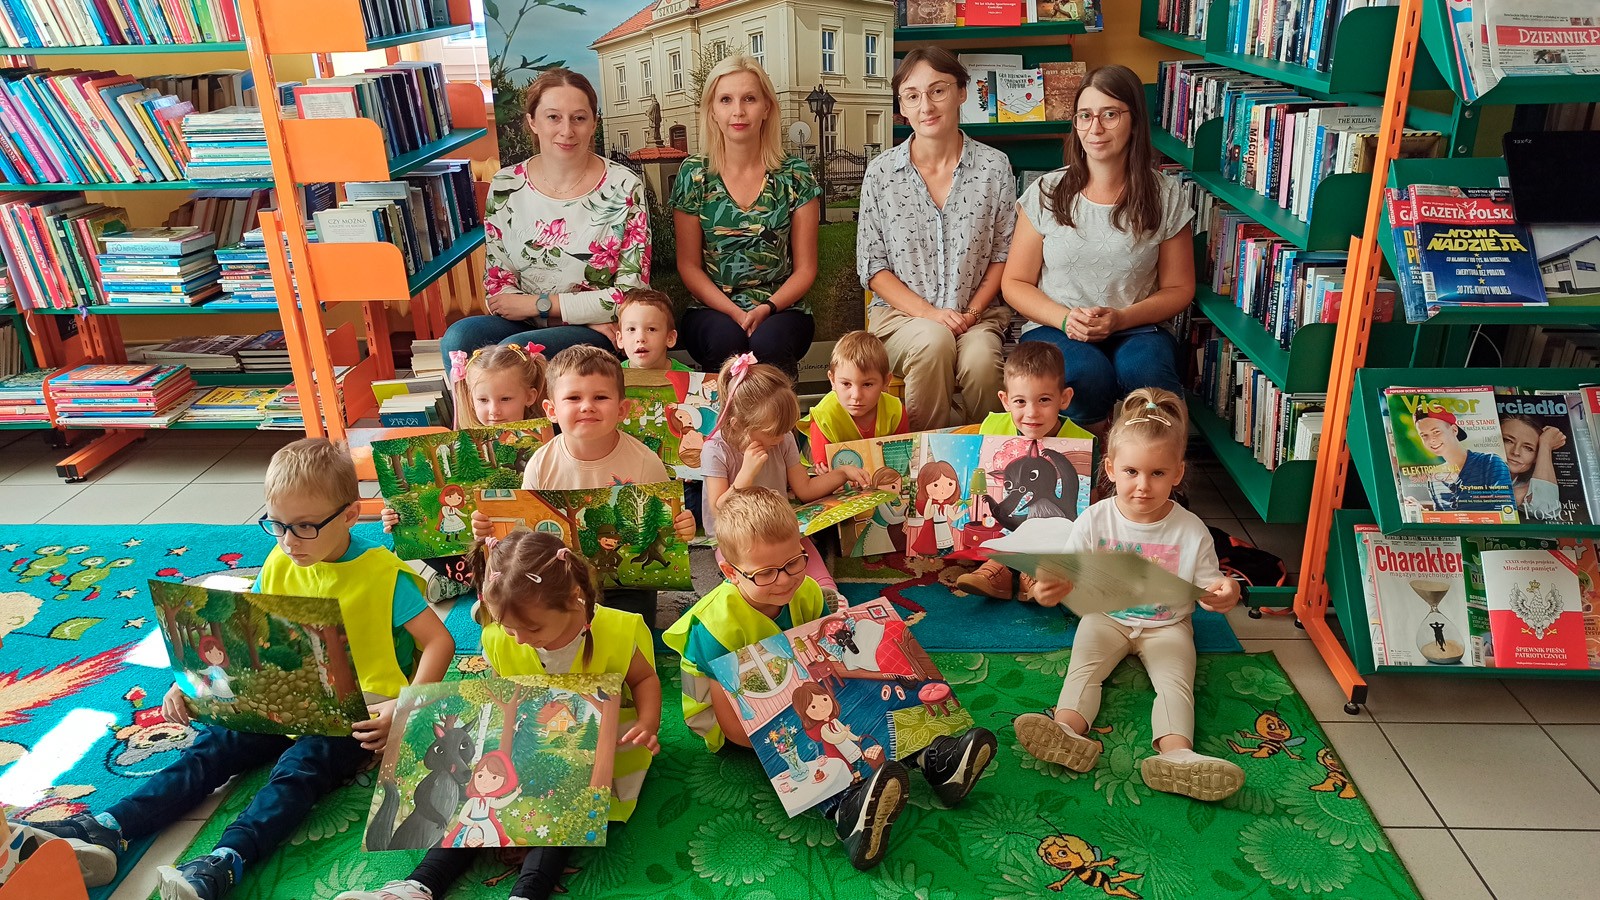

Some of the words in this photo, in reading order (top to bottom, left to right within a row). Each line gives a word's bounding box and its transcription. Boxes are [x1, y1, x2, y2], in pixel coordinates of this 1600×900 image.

[1518, 28, 1589, 44] DZIENNIK
[1247, 128, 1257, 175] MACOCHY
[1420, 205, 1466, 219] GAZETA
[1434, 229, 1515, 238] NOWA
[1427, 238, 1528, 252] NADZIEJA
[1491, 286, 1511, 295] WOLNEJ
[1401, 395, 1480, 414] Victor
[1496, 399, 1568, 415] rciadło
[1466, 420, 1475, 428] SIĘ
[1460, 484, 1484, 492] Czytam
[1098, 539, 1143, 553] PAYA
[1375, 545, 1463, 573] Charakter
